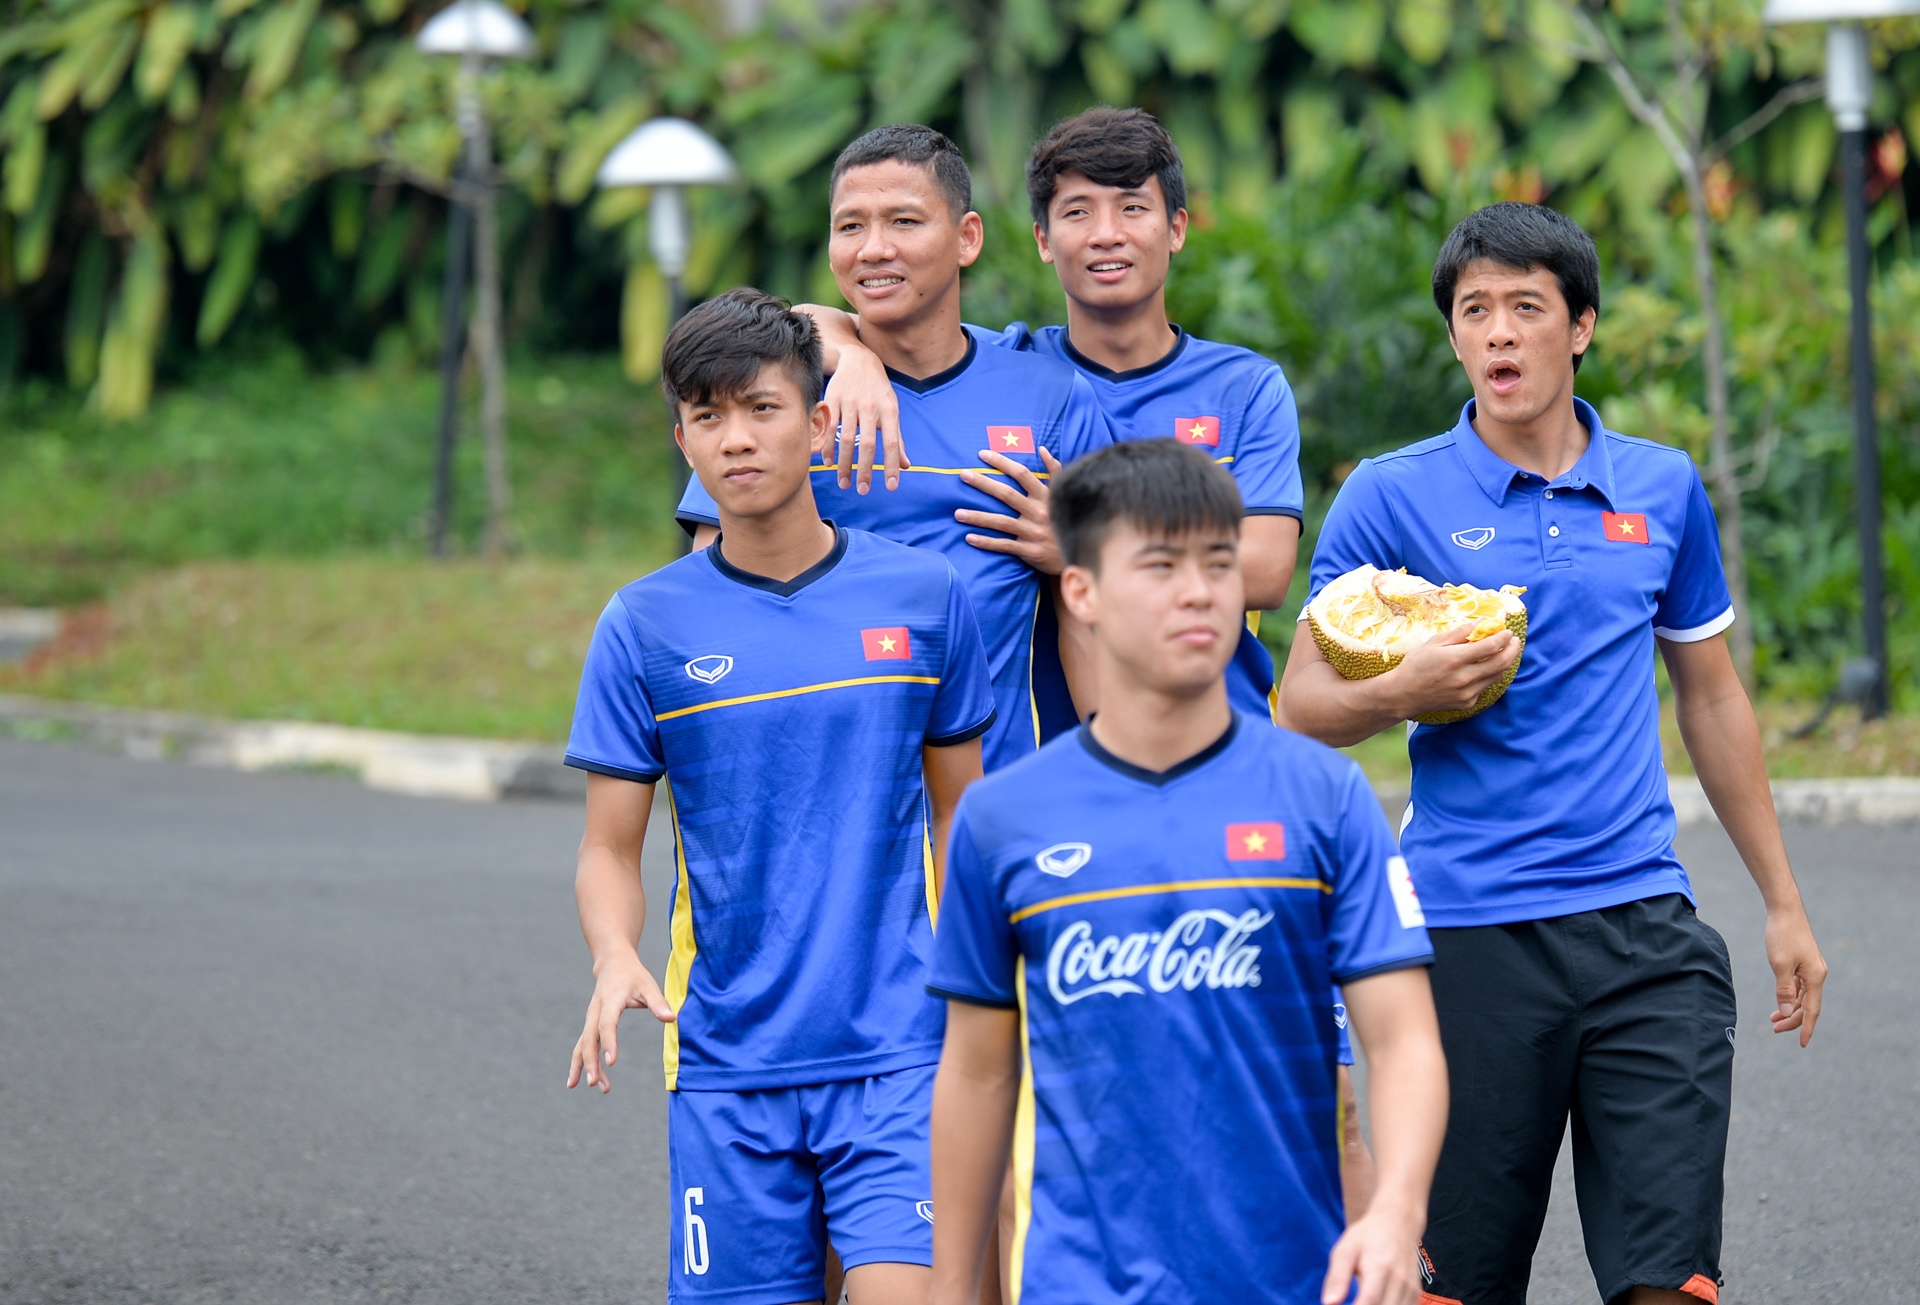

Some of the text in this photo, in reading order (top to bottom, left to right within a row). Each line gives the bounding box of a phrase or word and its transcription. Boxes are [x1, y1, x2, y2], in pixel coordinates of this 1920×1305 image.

[1047, 908, 1275, 1006] Coca-Cola
[684, 1187, 710, 1275] 6
[1420, 1247, 1436, 1274] SPORT
